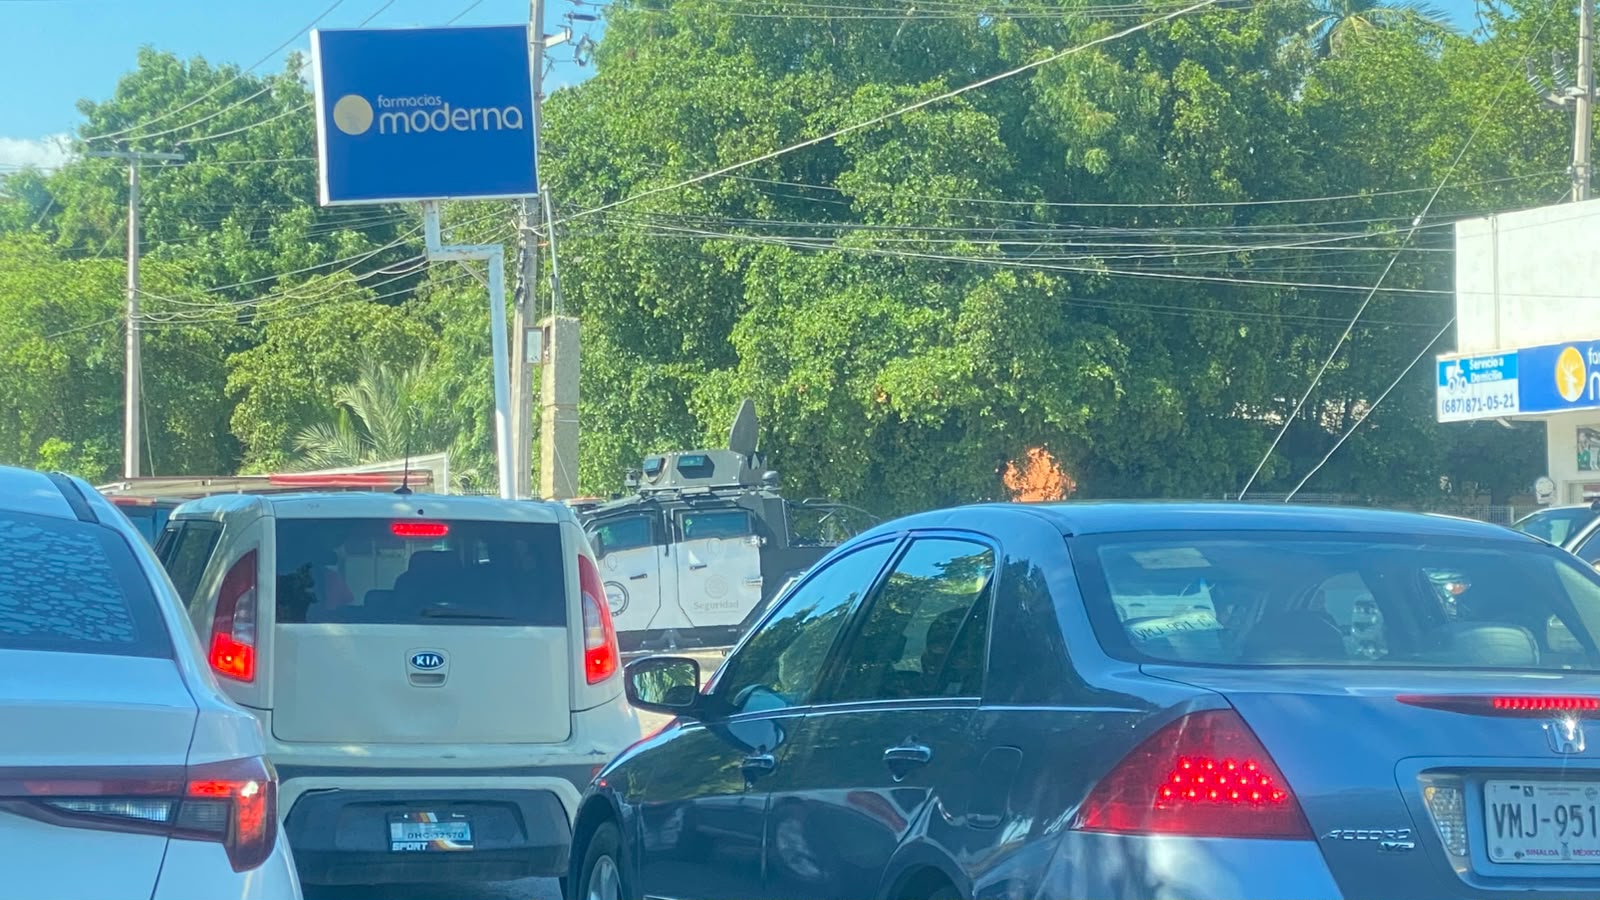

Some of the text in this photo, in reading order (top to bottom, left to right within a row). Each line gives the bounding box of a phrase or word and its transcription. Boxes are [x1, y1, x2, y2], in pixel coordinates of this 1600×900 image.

[377, 94, 442, 108] farmacias
[379, 102, 523, 134] moderna
[1469, 356, 1499, 370] Servicio
[1470, 369, 1503, 383] Domicilio
[1442, 393, 1515, 415] (687)871-05-21
[693, 599, 740, 611] Seguridad
[416, 655, 440, 666] KIA
[392, 841, 428, 851] SPORT
[1525, 848, 1559, 857] SINALOA
